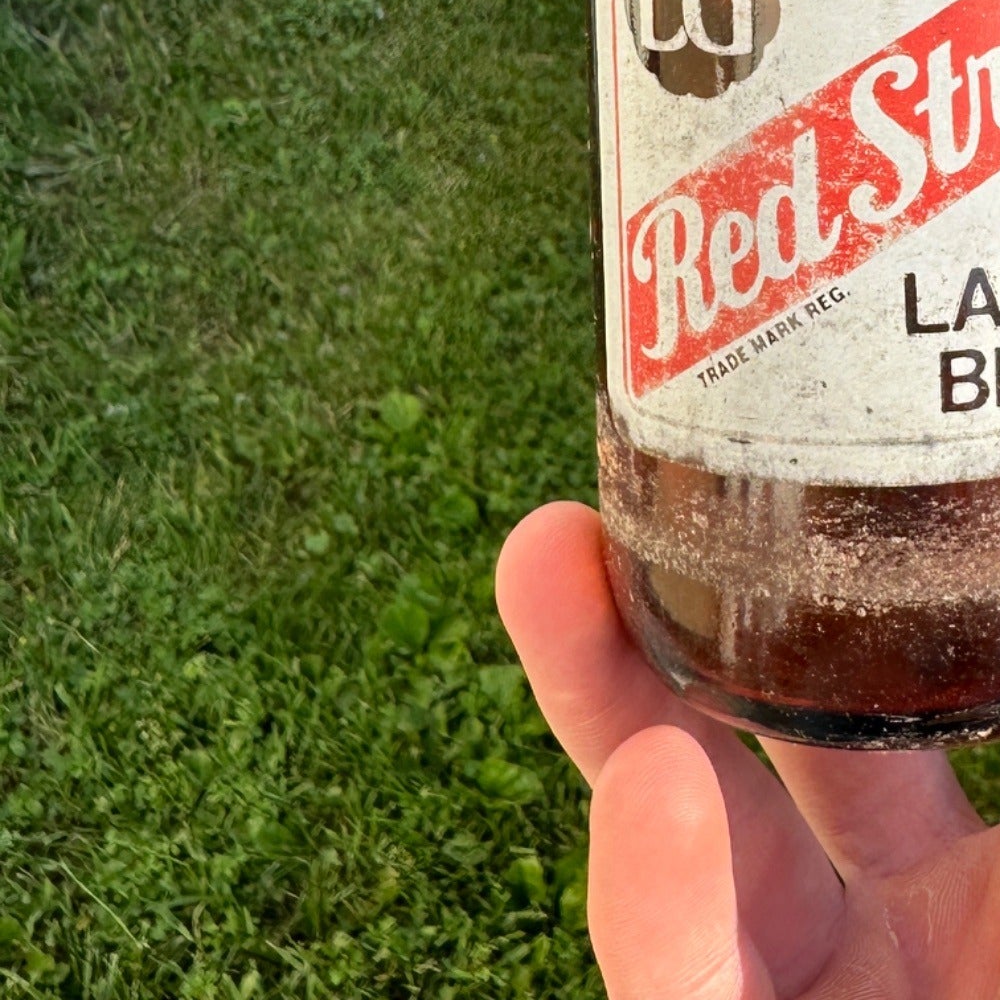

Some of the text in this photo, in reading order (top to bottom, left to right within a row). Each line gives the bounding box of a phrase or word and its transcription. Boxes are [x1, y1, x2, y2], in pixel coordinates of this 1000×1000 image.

[632, 127, 843, 360] Red
[697, 286, 851, 388] TRADE MARK REG.
